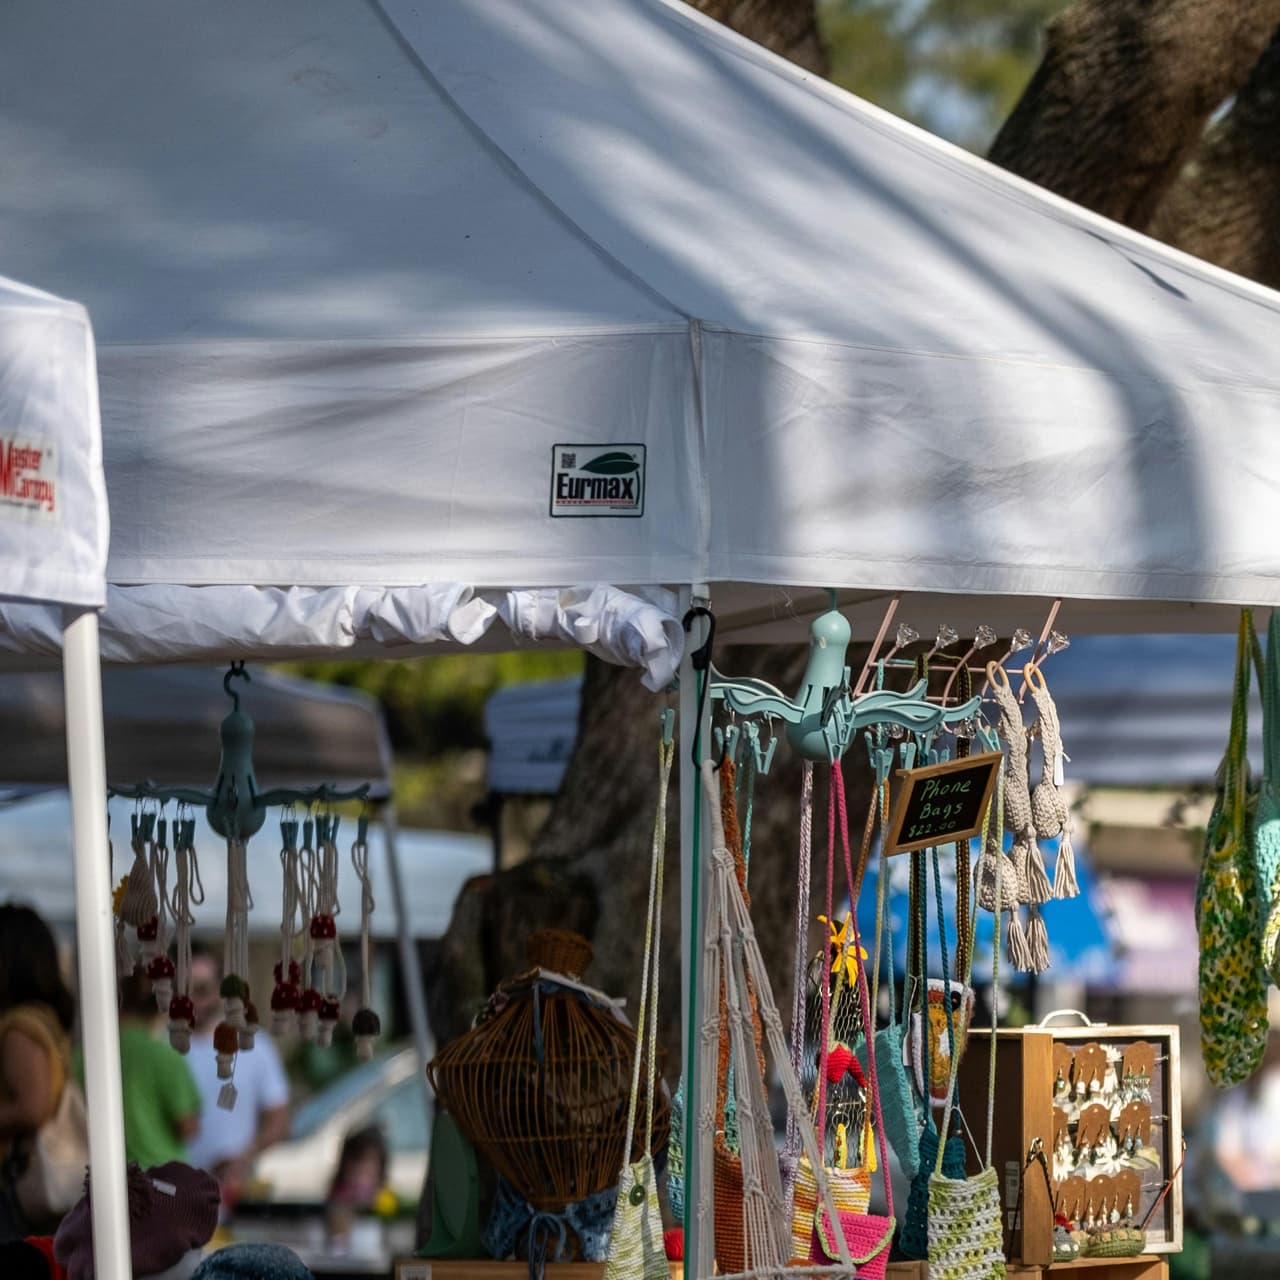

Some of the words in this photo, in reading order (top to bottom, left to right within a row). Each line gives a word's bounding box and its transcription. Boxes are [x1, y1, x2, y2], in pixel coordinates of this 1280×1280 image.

[556, 473, 635, 500] Eurmax
[920, 778, 971, 802] Phone
[919, 802, 964, 820] Bags
